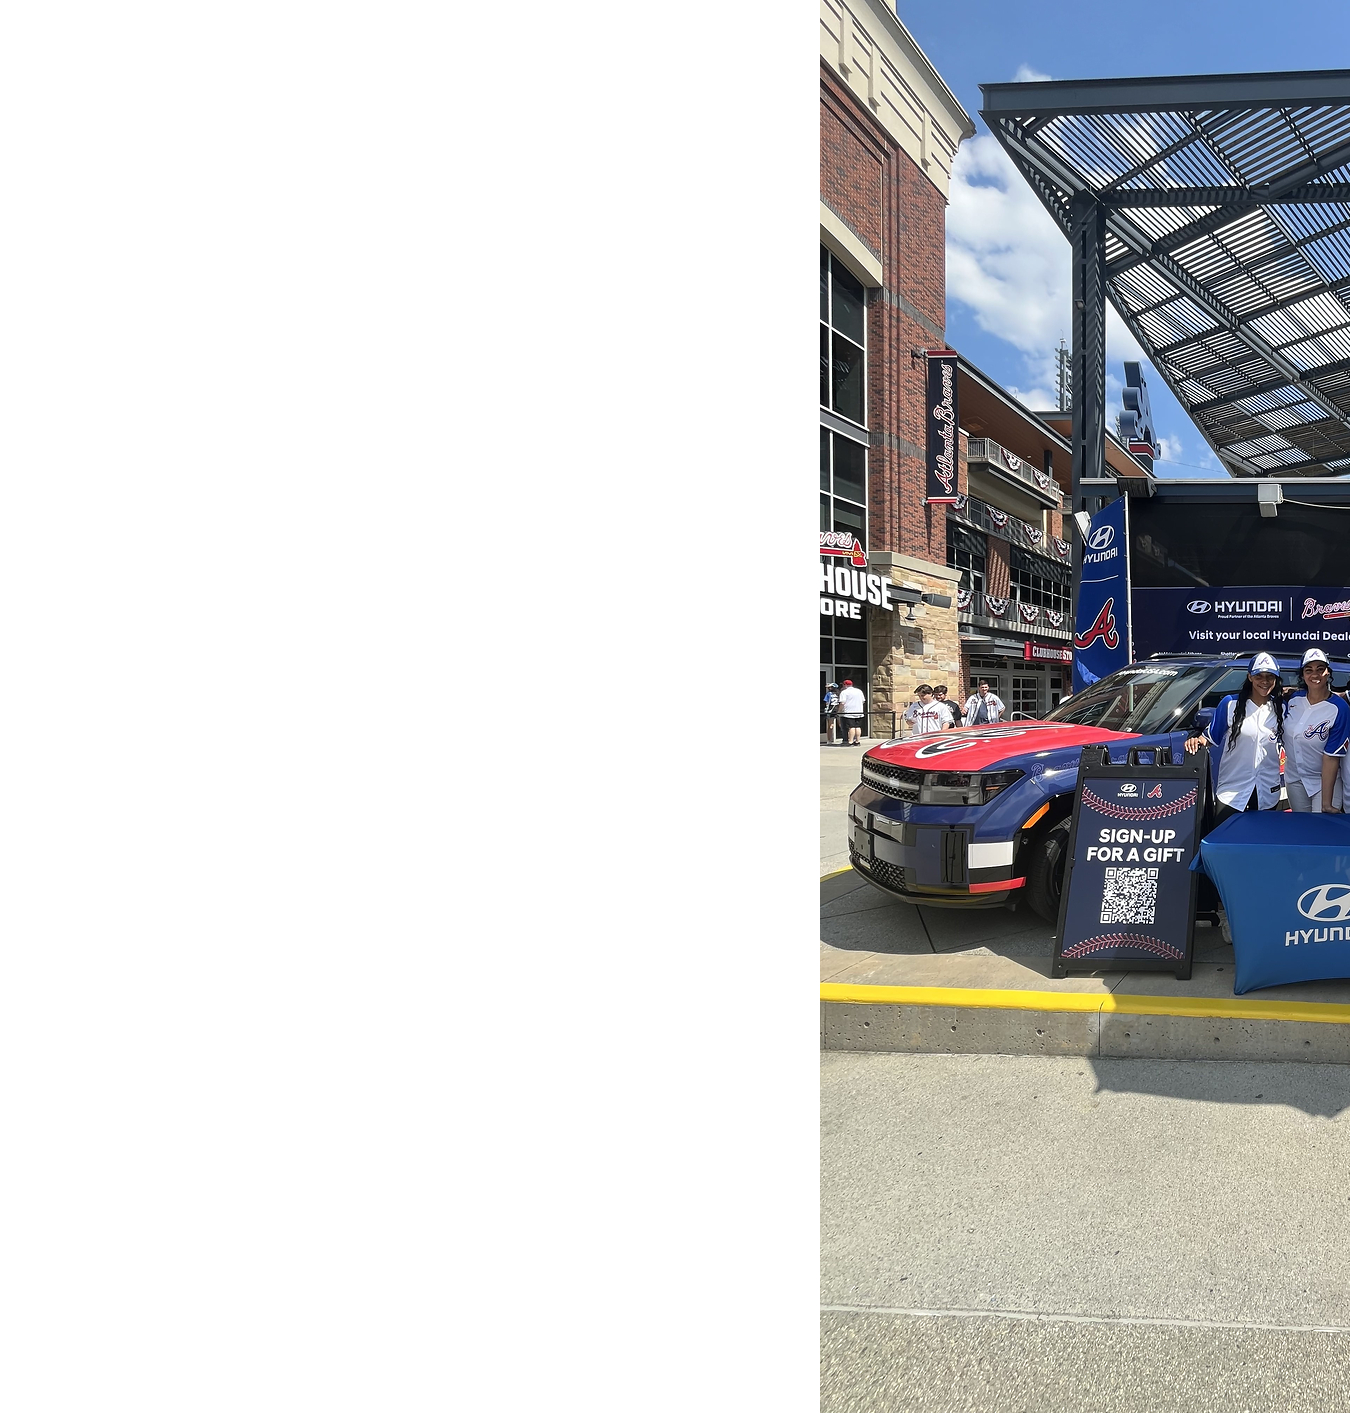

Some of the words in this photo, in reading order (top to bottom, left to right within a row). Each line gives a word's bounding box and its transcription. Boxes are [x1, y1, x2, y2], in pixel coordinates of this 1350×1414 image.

[933, 364, 955, 426] Braves
[934, 423, 954, 494] Atlanta
[1082, 547, 1118, 564] HYUNDAI
[1214, 600, 1282, 612] HYUNDAI
[1188, 630, 1213, 640] Visit
[1215, 632, 1241, 641] your
[1242, 630, 1270, 640] local
[1273, 630, 1320, 641] Hyundai
[1032, 645, 1063, 660] CLUBHOUSE
[1062, 649, 1072, 661] STO
[1098, 828, 1176, 844] SIGN-UP
[1086, 846, 1124, 862] FOR
[1126, 847, 1140, 861] A
[1143, 847, 1185, 862] GIFT
